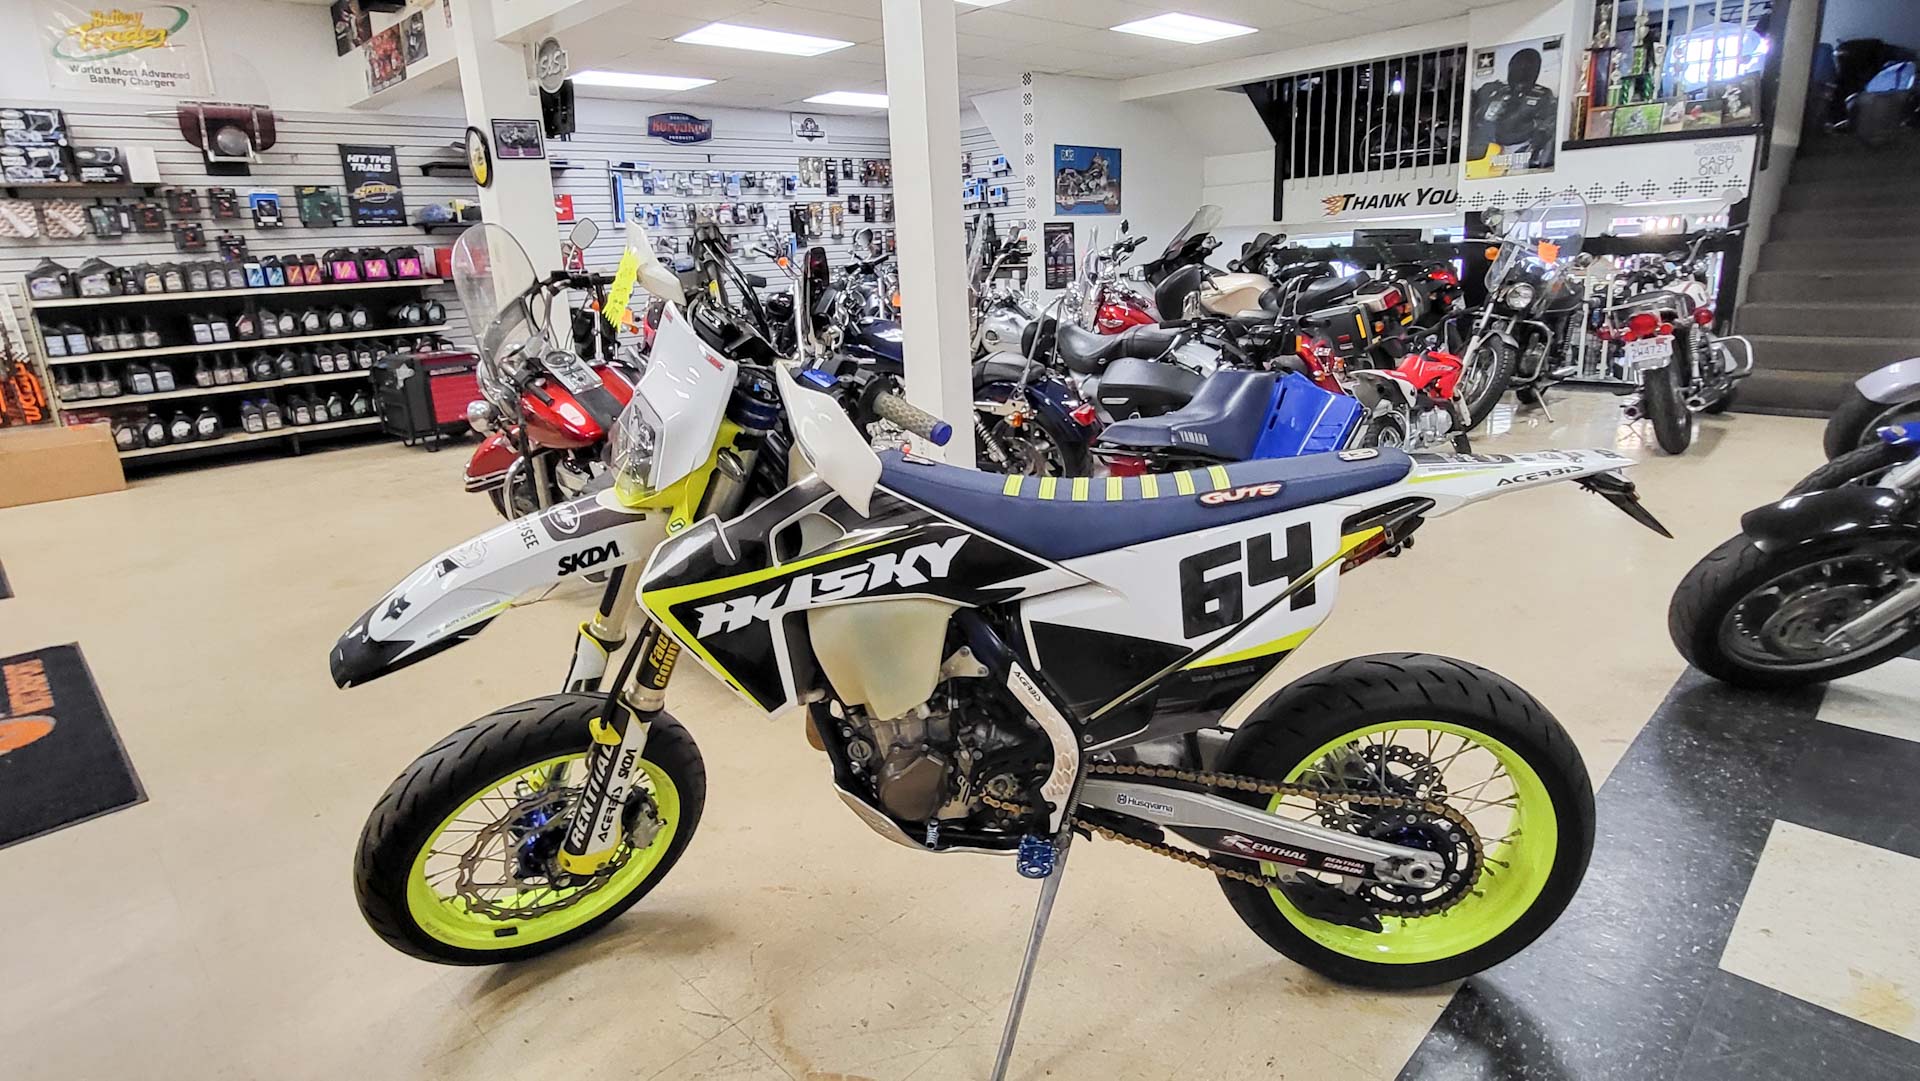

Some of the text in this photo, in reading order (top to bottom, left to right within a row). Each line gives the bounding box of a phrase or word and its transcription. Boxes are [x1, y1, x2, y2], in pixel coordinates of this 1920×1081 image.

[90, 9, 143, 28] Battery
[66, 24, 168, 50] Tender
[69, 64, 190, 80] World's Most Advanced
[90, 74, 176, 89] Battery Chargers
[347, 154, 391, 164] HIT THE
[1699, 156, 1734, 166] CASH
[350, 163, 392, 173] TRAILS
[1698, 163, 1734, 176] ONLY
[1342, 187, 1457, 211] THANK YOU
[1178, 430, 1209, 447] YAMAHA
[1496, 466, 1585, 487] ACERBIS
[1200, 482, 1283, 505] GUTS
[557, 540, 621, 576] SKDA
[694, 534, 972, 639] HUSKY
[1179, 521, 1317, 640] 64
[618, 749, 637, 779] SKDA
[1128, 797, 1174, 812] Husqvarna
[1324, 856, 1366, 869] RENTHAL
[1324, 862, 1363, 875] CHAIN
